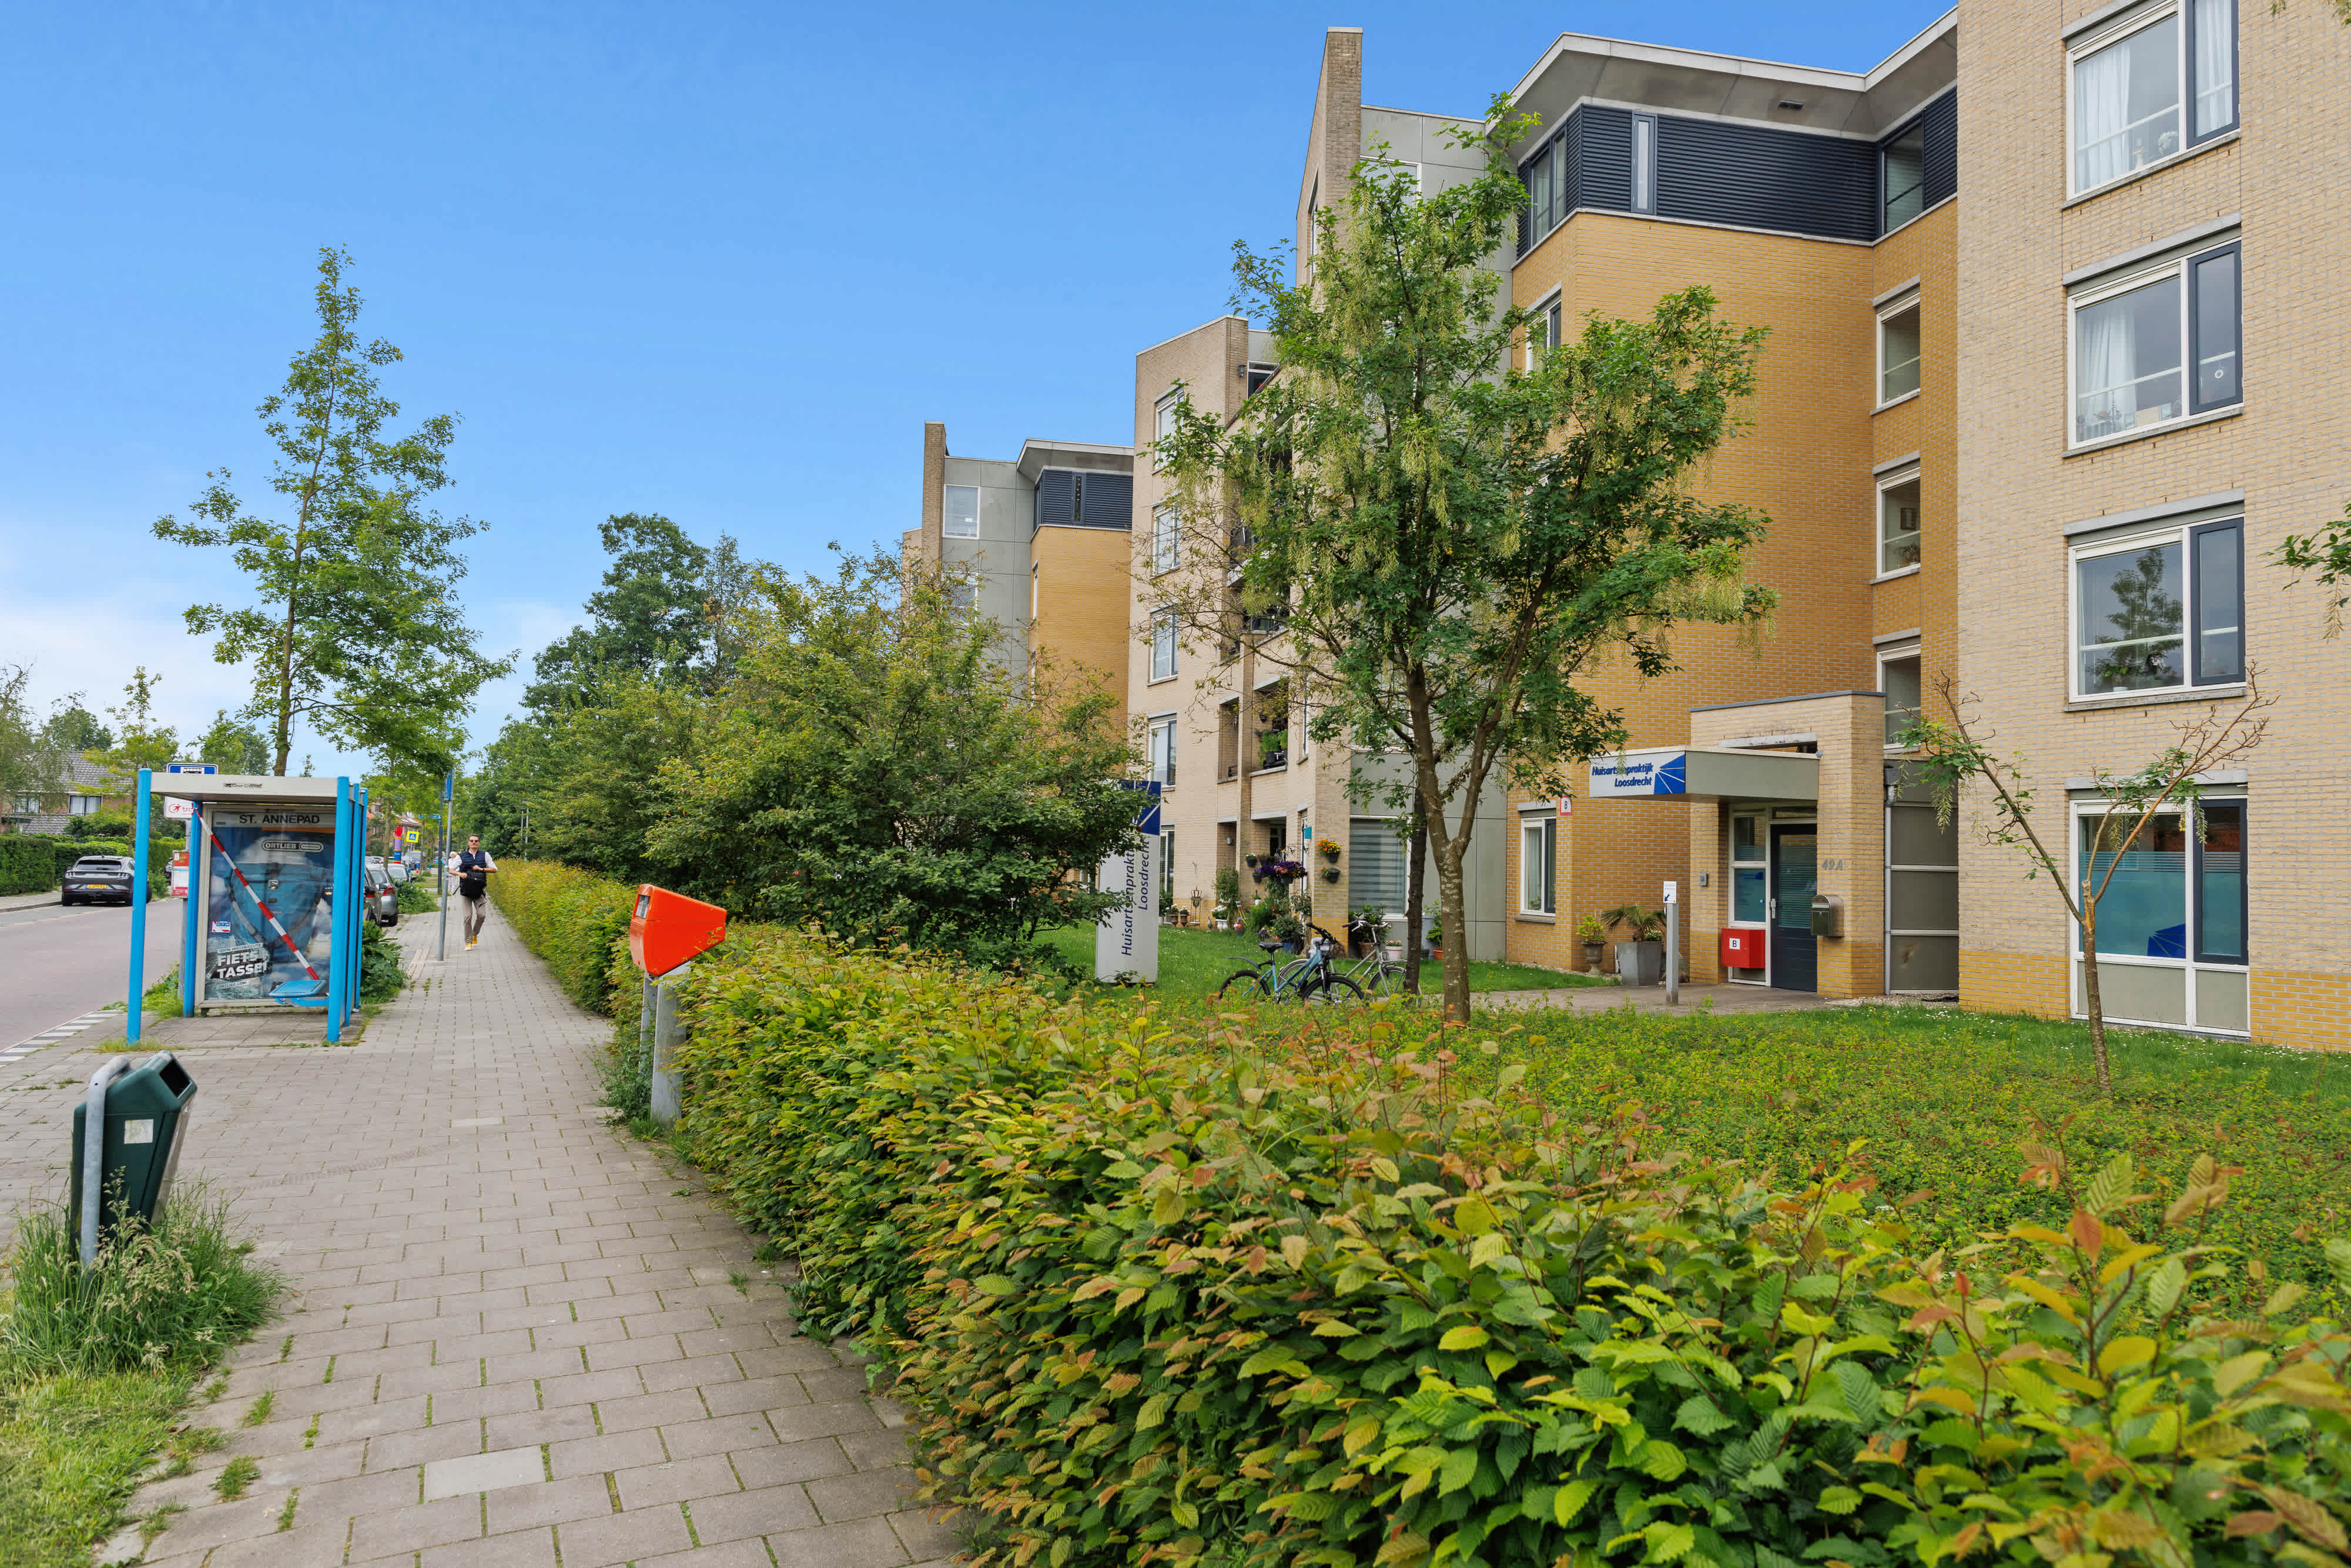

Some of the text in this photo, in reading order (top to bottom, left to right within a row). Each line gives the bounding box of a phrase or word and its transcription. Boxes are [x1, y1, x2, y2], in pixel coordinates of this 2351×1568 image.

[1592, 762, 1653, 775] Huisartpraktijk
[1614, 776, 1652, 787] Loosdrecht
[1565, 800, 1568, 809] B
[239, 815, 320, 823] ST. ANNEPAD
[1138, 841, 1150, 910] Loosdrecht
